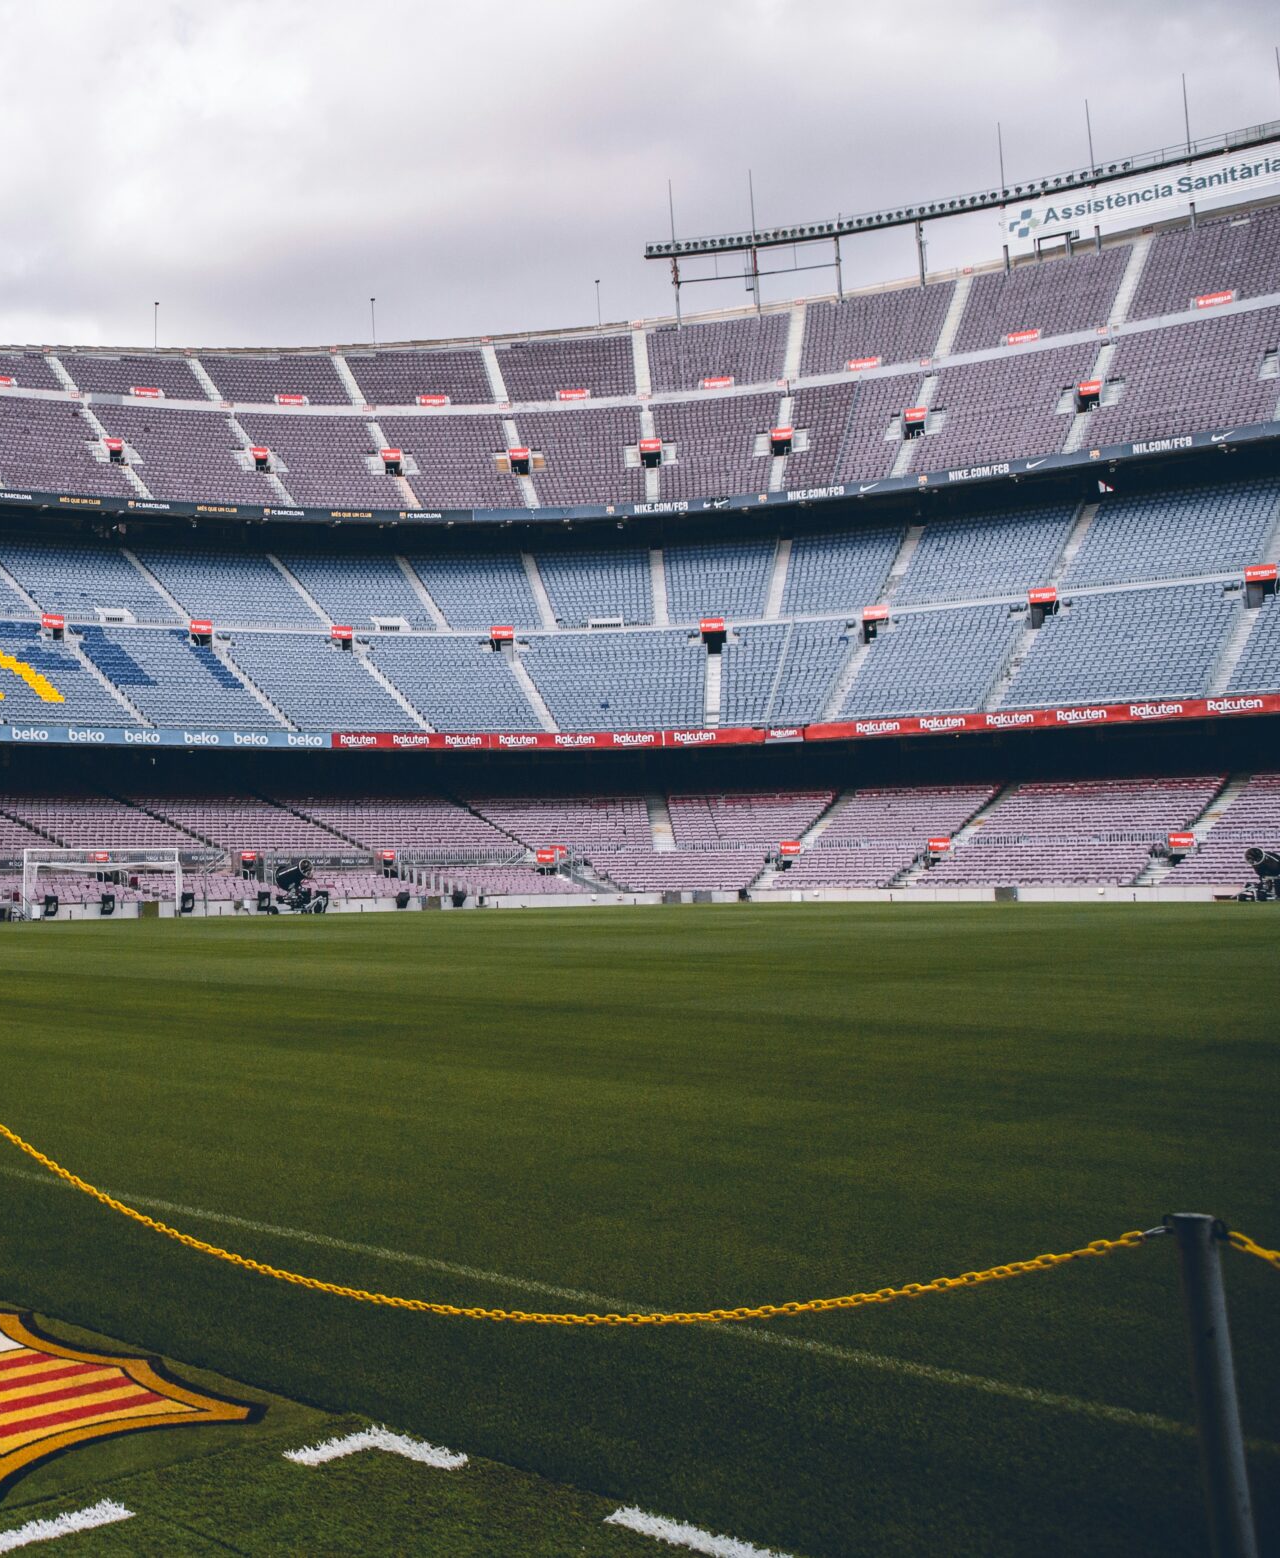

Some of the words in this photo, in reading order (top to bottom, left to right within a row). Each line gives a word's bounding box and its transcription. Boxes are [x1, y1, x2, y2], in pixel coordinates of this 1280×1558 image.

[1043, 184, 1172, 224] Assistència
[1176, 156, 1280, 193] Sanitària
[949, 464, 1009, 481] NIKE.COM/FCB
[634, 502, 688, 514] NIKE.COM/FCB
[1130, 704, 1182, 716] Rakuten
[1207, 698, 1263, 711] Rakuten
[986, 713, 1034, 725] Rakuten
[1057, 708, 1107, 721] Rakuten
[856, 721, 900, 733] Rakuten
[920, 717, 965, 729] Rakuten
[12, 727, 48, 741] beko
[69, 729, 104, 742] beko
[125, 730, 160, 743] beko
[184, 732, 218, 744] beko
[234, 732, 268, 745] beko
[613, 733, 654, 743] Rakuten
[674, 732, 715, 742] Rakuten
[771, 729, 797, 737] Rakuten
[288, 734, 322, 746] beko
[340, 734, 376, 745] Rakuten
[393, 735, 429, 745] Rakuten
[445, 735, 481, 745] Rakuten
[499, 735, 537, 744] Rakuten
